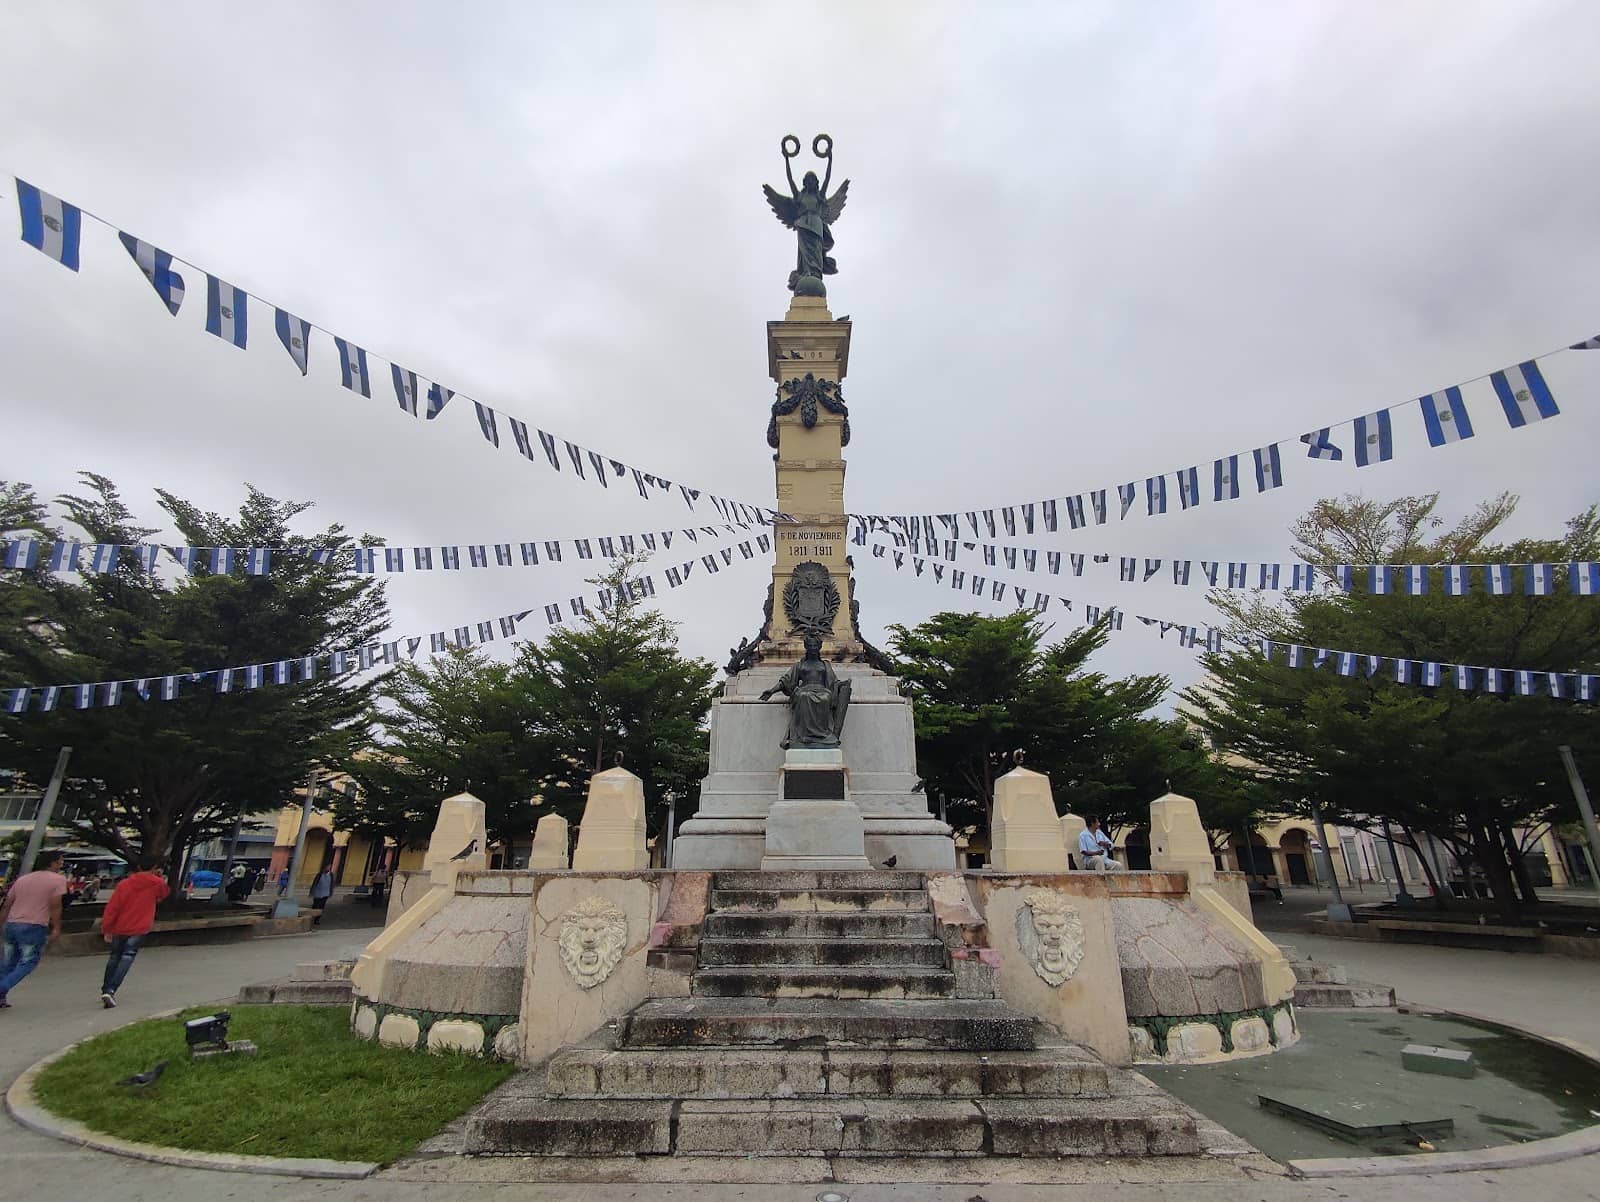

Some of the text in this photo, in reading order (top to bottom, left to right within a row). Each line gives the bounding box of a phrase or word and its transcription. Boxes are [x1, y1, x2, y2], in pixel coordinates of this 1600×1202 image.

[787, 532, 797, 540] DE
[798, 531, 842, 540] NOVIEMBRE
[789, 546, 832, 556] 1811 1911
